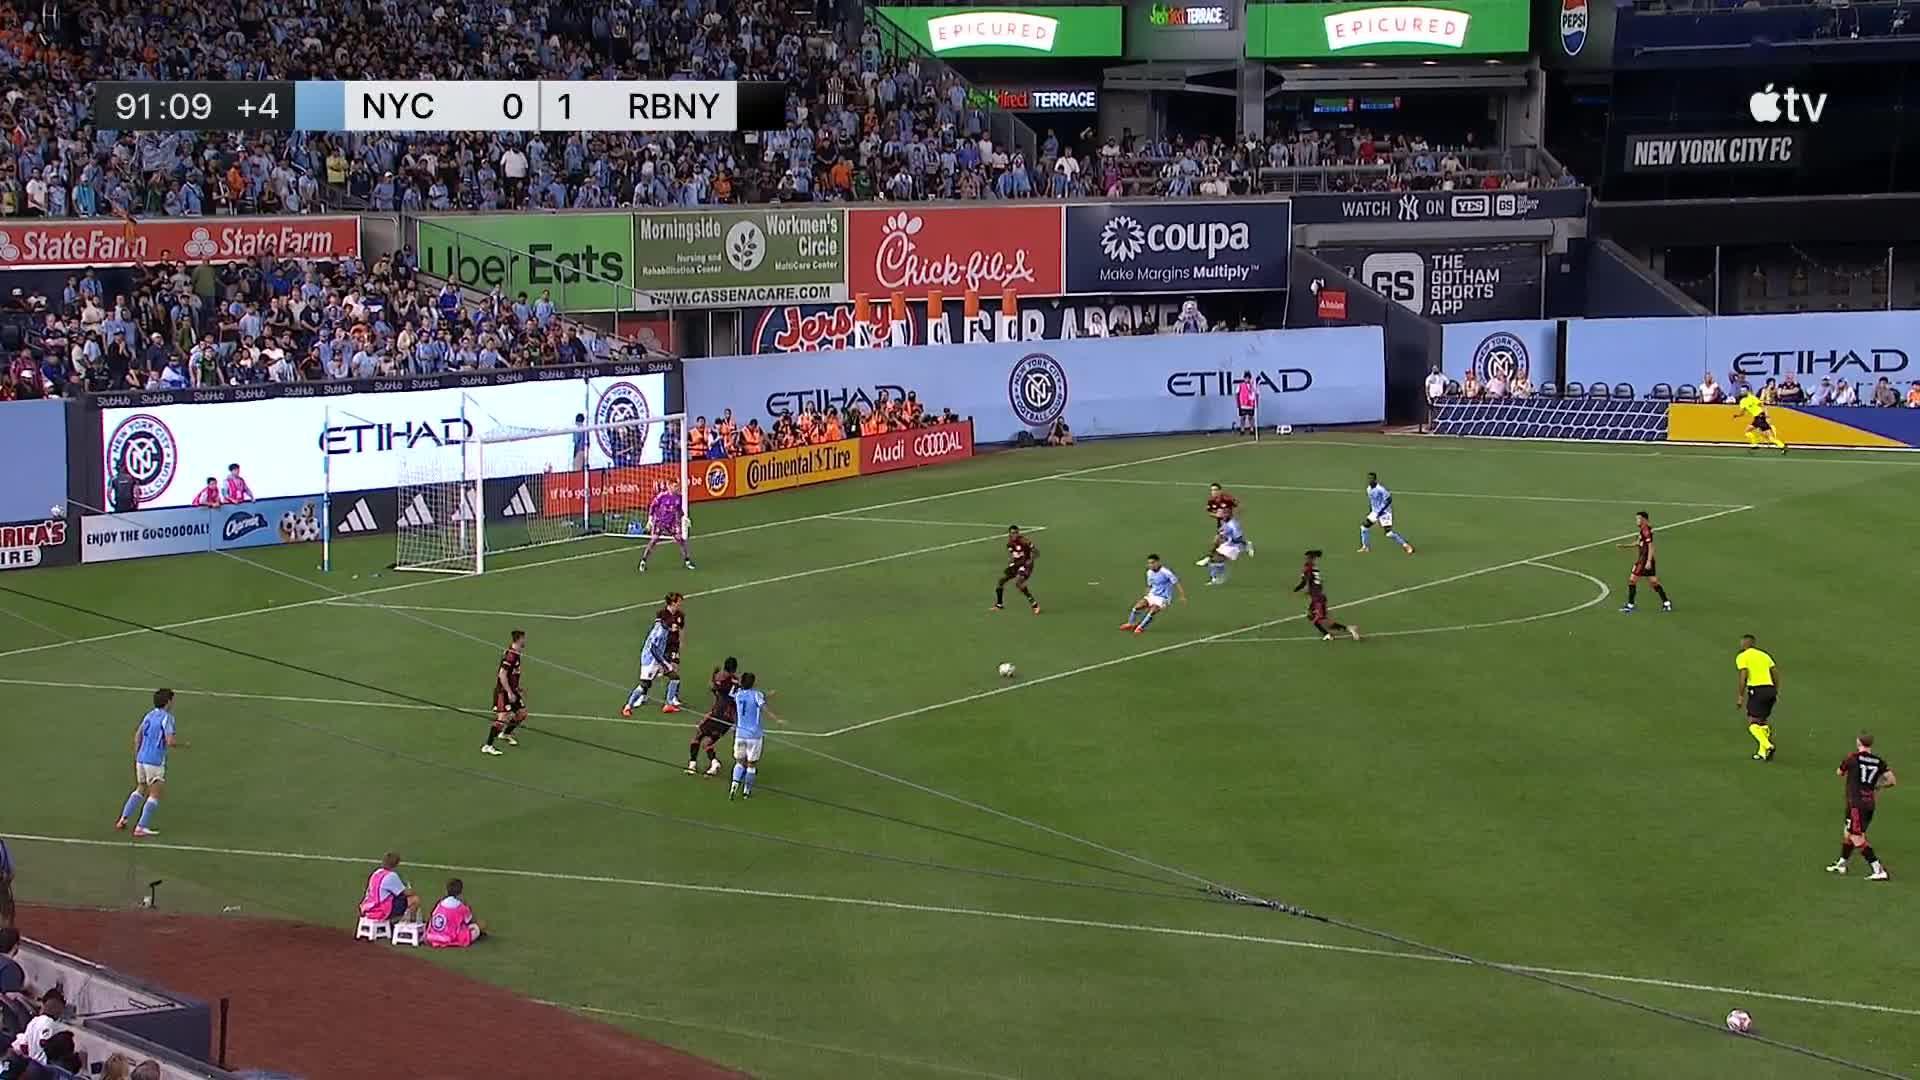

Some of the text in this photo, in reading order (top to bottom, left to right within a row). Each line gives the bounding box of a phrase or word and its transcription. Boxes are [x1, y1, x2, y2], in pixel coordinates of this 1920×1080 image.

[1186, 7, 1222, 24] TERRACE
[1562, 13, 1585, 28] PEPSI
[937, 22, 1048, 41] EPICURED
[1335, 17, 1457, 38] EPICURED
[1032, 91, 1095, 107] TERRACE
[1634, 137, 1792, 166] NEW YORK CITY FC
[1342, 200, 1391, 217] WATCH
[1426, 199, 1445, 215] ON
[1457, 200, 1484, 212] YES
[640, 217, 721, 244] Morningside
[766, 213, 838, 235] Workmen's
[798, 235, 838, 256] Circle
[1147, 222, 1249, 260] coupa
[427, 244, 624, 286] Uber Eats
[876, 226, 1035, 291] Chick-fil-A
[1431, 254, 1465, 270] THE
[1100, 266, 1134, 281] Make
[1137, 265, 1190, 283] Margins
[1431, 268, 1500, 285] GOTHAM
[1371, 270, 1415, 301] GS
[1431, 284, 1494, 300] SPORTS
[650, 285, 831, 305] WWW.CASSENACARE.COM
[1430, 299, 1463, 315] APP
[775, 302, 892, 350] Jersy
[614, 363, 641, 375] StubHub
[648, 361, 673, 373] StubHub
[1732, 349, 1909, 376] ETIHAD
[411, 377, 440, 389] StubHub
[460, 375, 488, 386] StubHub
[496, 372, 523, 384] StubHub
[539, 369, 565, 380] StubHub
[1167, 368, 1313, 397] ETIHAD
[235, 388, 266, 400] StubHub
[284, 385, 314, 397] StubHub
[323, 383, 353, 395] StubHub
[374, 380, 403, 392] StubHub
[97, 396, 131, 407] StubHub
[141, 393, 174, 404] StubHub
[194, 390, 224, 402] StubHub
[318, 417, 474, 455] ETIHAD
[872, 439, 905, 464] Audi
[746, 446, 850, 489] Continental Tire
[591, 486, 601, 496] to
[691, 475, 703, 486] be
[709, 470, 727, 487] Tide
[0, 520, 65, 548] RICA'S
[86, 531, 118, 547] ENJOY
[121, 529, 139, 543] THE
[1859, 763, 1879, 784] 17
